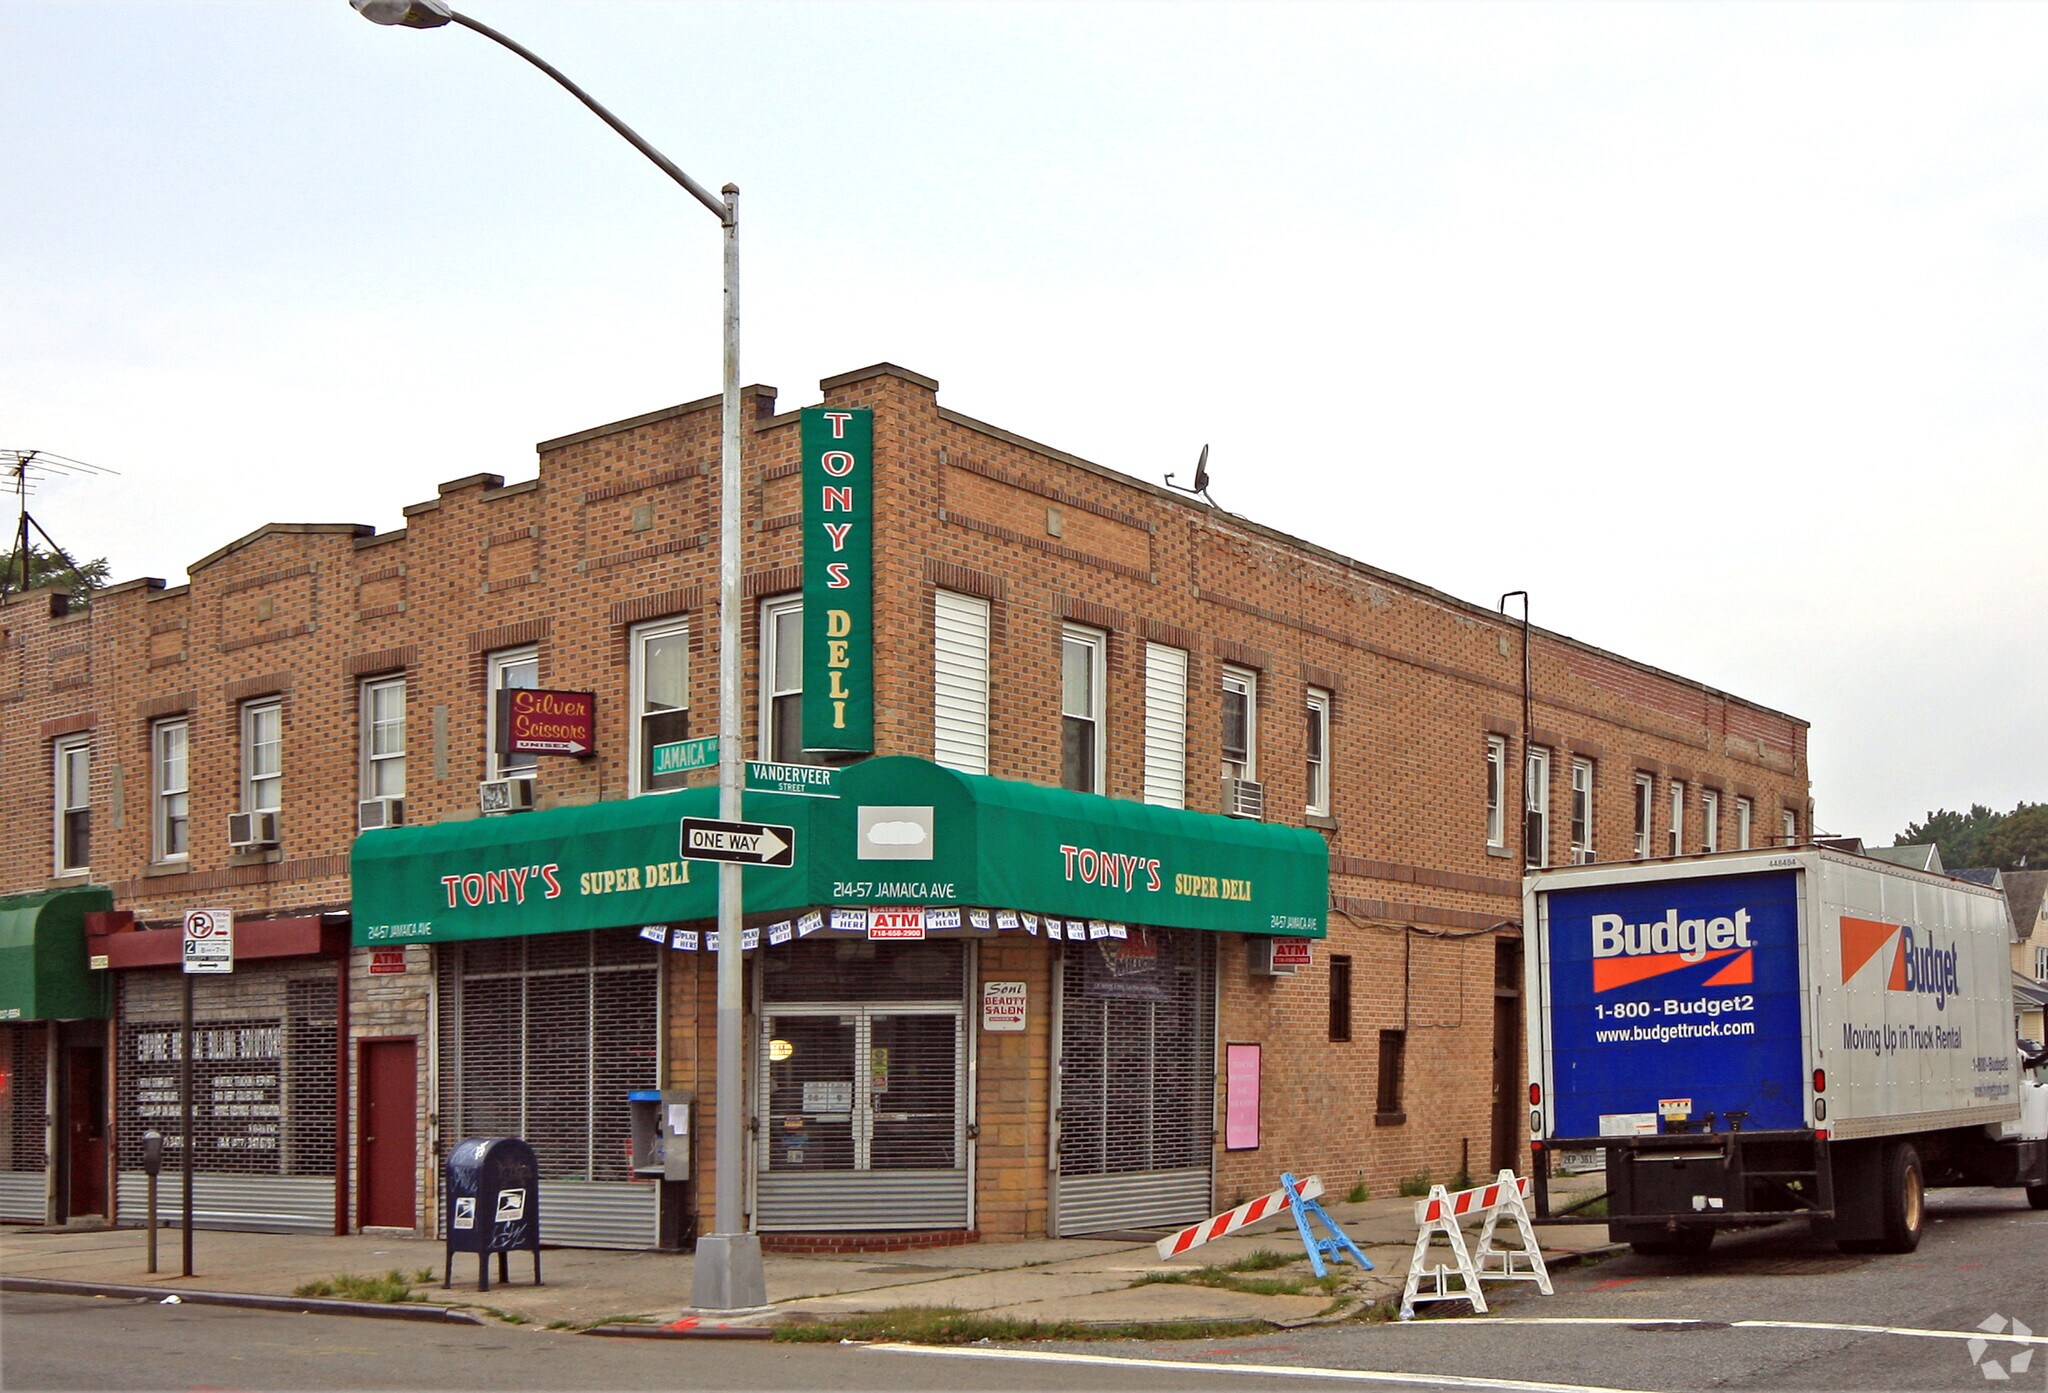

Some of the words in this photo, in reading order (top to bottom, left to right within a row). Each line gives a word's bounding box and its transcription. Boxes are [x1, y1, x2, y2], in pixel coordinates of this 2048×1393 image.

[821, 412, 855, 589] TONYS
[826, 609, 850, 729] DELI
[514, 692, 586, 716] Silver
[515, 715, 586, 739] Scissors
[657, 742, 705, 771] JAMAICA
[753, 763, 831, 786] VANDERVEER
[778, 782, 806, 792] STREET
[693, 831, 724, 849] ONE
[729, 834, 760, 852] WAY
[1060, 844, 1161, 893] TONY'S
[1175, 873, 1219, 899] SUPER
[1221, 878, 1251, 902] DELI
[441, 863, 561, 908] TONY'S
[580, 867, 641, 896] SUPER
[645, 860, 690, 889] DELI
[833, 881, 873, 898] 214-57
[875, 882, 928, 898] JAMAICA
[840, 920, 864, 928] HERE
[841, 912, 864, 920] PLAY
[874, 914, 919, 927] ATM
[935, 918, 959, 927] HERE
[936, 911, 958, 919] PLAY
[681, 932, 697, 941] PLAY
[1591, 907, 1752, 963] Budget
[186, 941, 195, 954] 2
[1276, 944, 1308, 955] ATM
[373, 953, 403, 964] ATM
[1901, 925, 1959, 1011] Budget
[985, 997, 1026, 1005] BEAUTY
[985, 1006, 1024, 1014] SALON
[1596, 1021, 1755, 1043] www.budgettruck.com
[1843, 1023, 1881, 1056] Moving
[1884, 1023, 1896, 1056] Up
[1899, 1024, 1908, 1049] in
[1909, 1025, 1934, 1050] Truck
[1935, 1026, 1962, 1049] Rental
